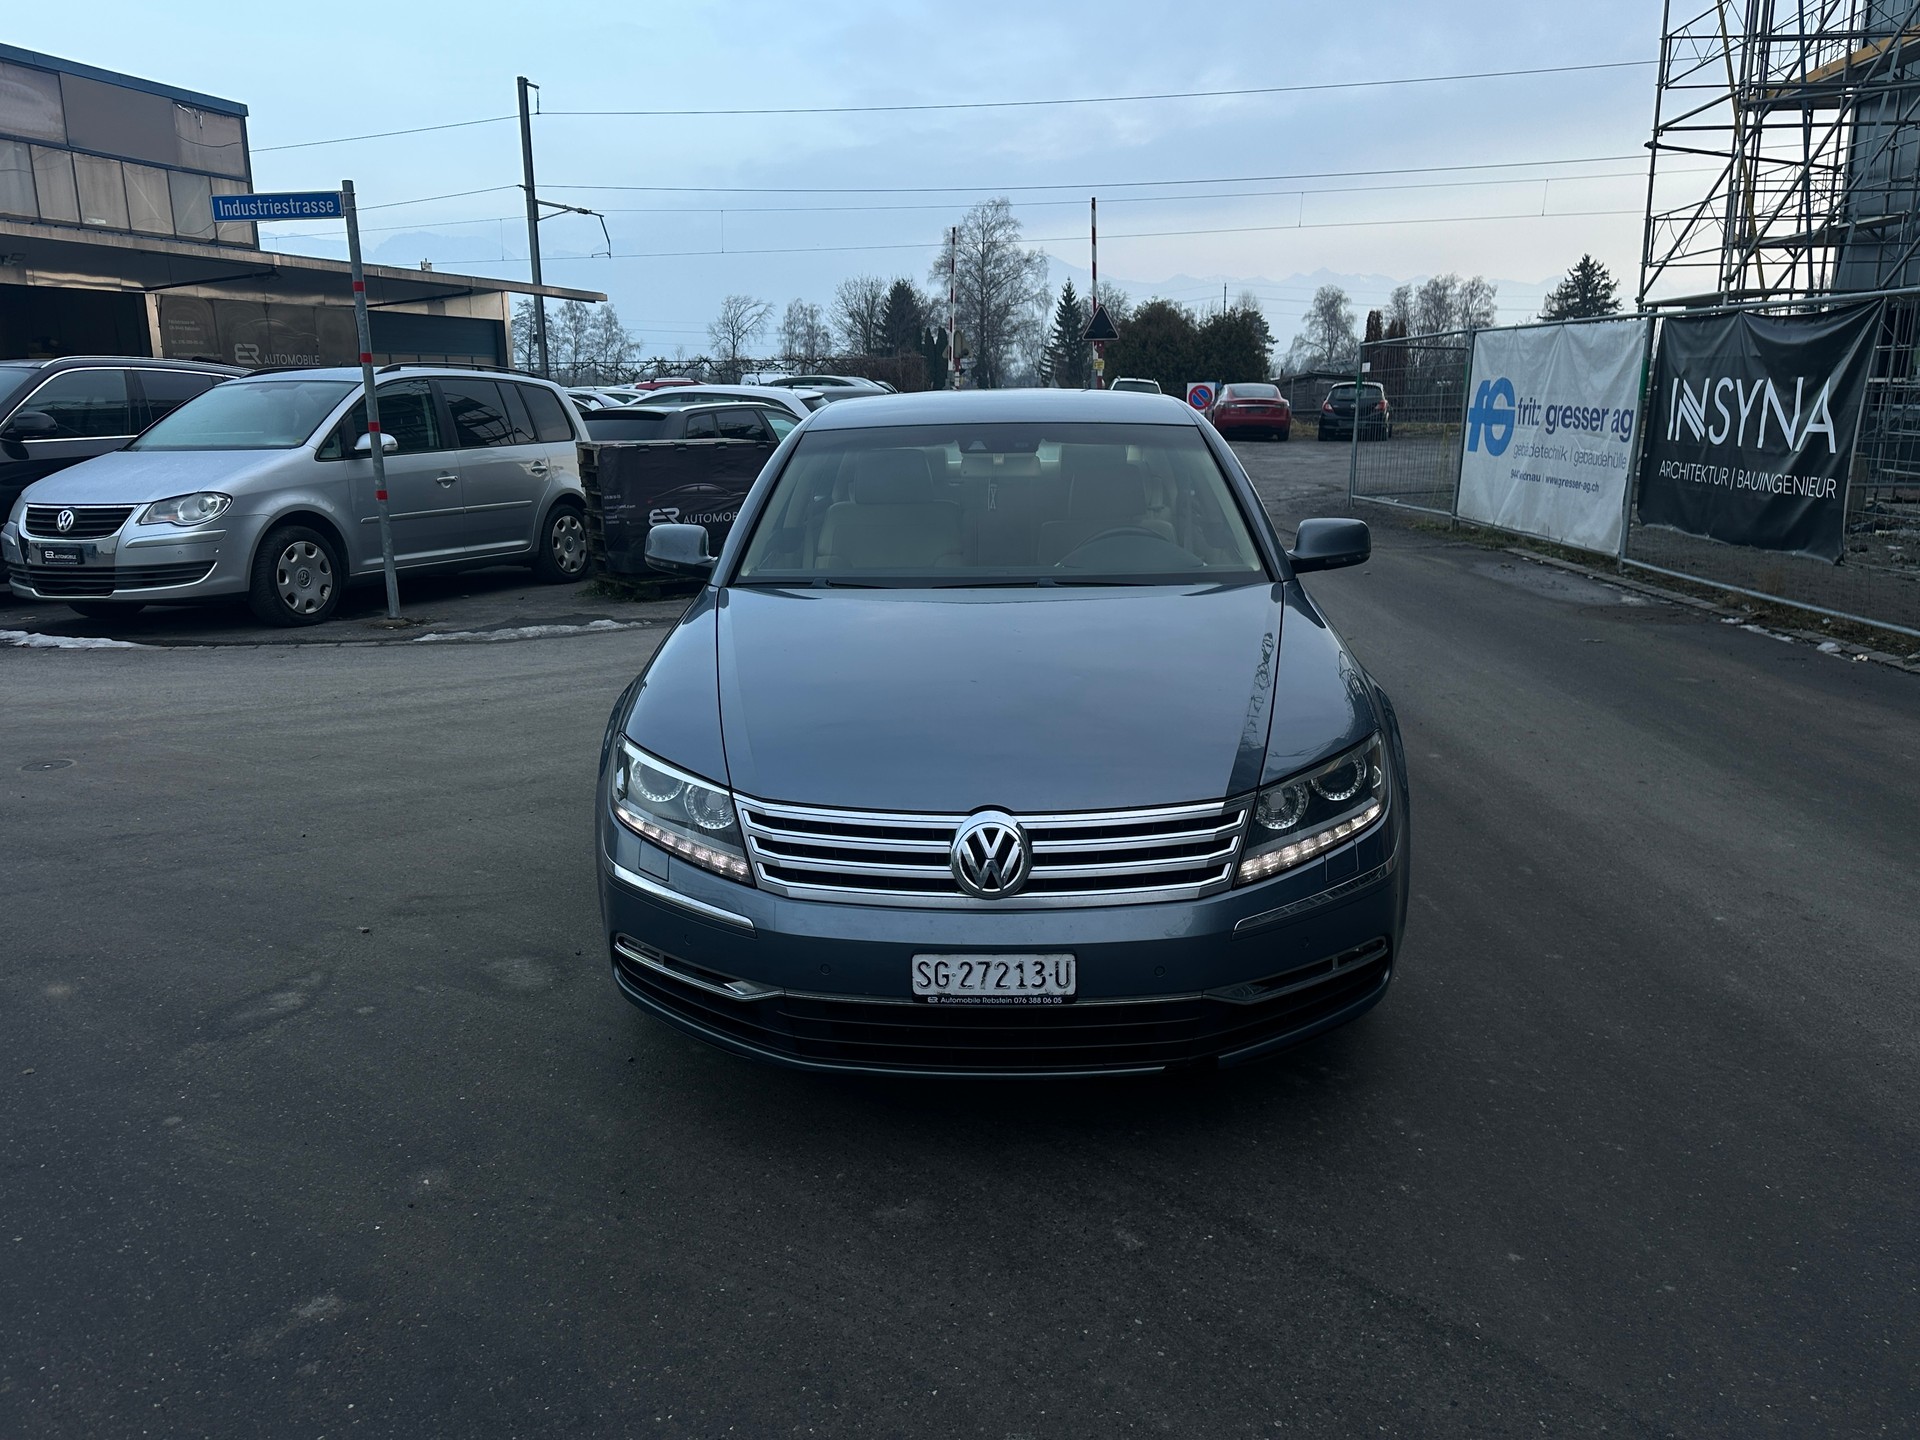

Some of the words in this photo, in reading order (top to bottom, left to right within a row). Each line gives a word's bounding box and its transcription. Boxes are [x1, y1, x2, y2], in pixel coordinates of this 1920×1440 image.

[218, 198, 335, 217] Industriestrasse
[264, 353, 320, 365] AUTOMOBILE
[1517, 397, 1542, 426] fritz
[1545, 404, 1610, 435] gresser
[1611, 408, 1634, 443] ag
[1667, 376, 1837, 454] INSYNA
[1659, 460, 1729, 486] ARCHITEKTUR
[1736, 469, 1837, 499] BAUINGENIEUR
[940, 996, 981, 1004] Automobile
[982, 996, 1012, 1004] Rebstein
[1013, 996, 1027, 1004] 076
[1028, 996, 1041, 1004] 388
[1042, 996, 1052, 1004] 06
[1053, 996, 1063, 1004] 05
